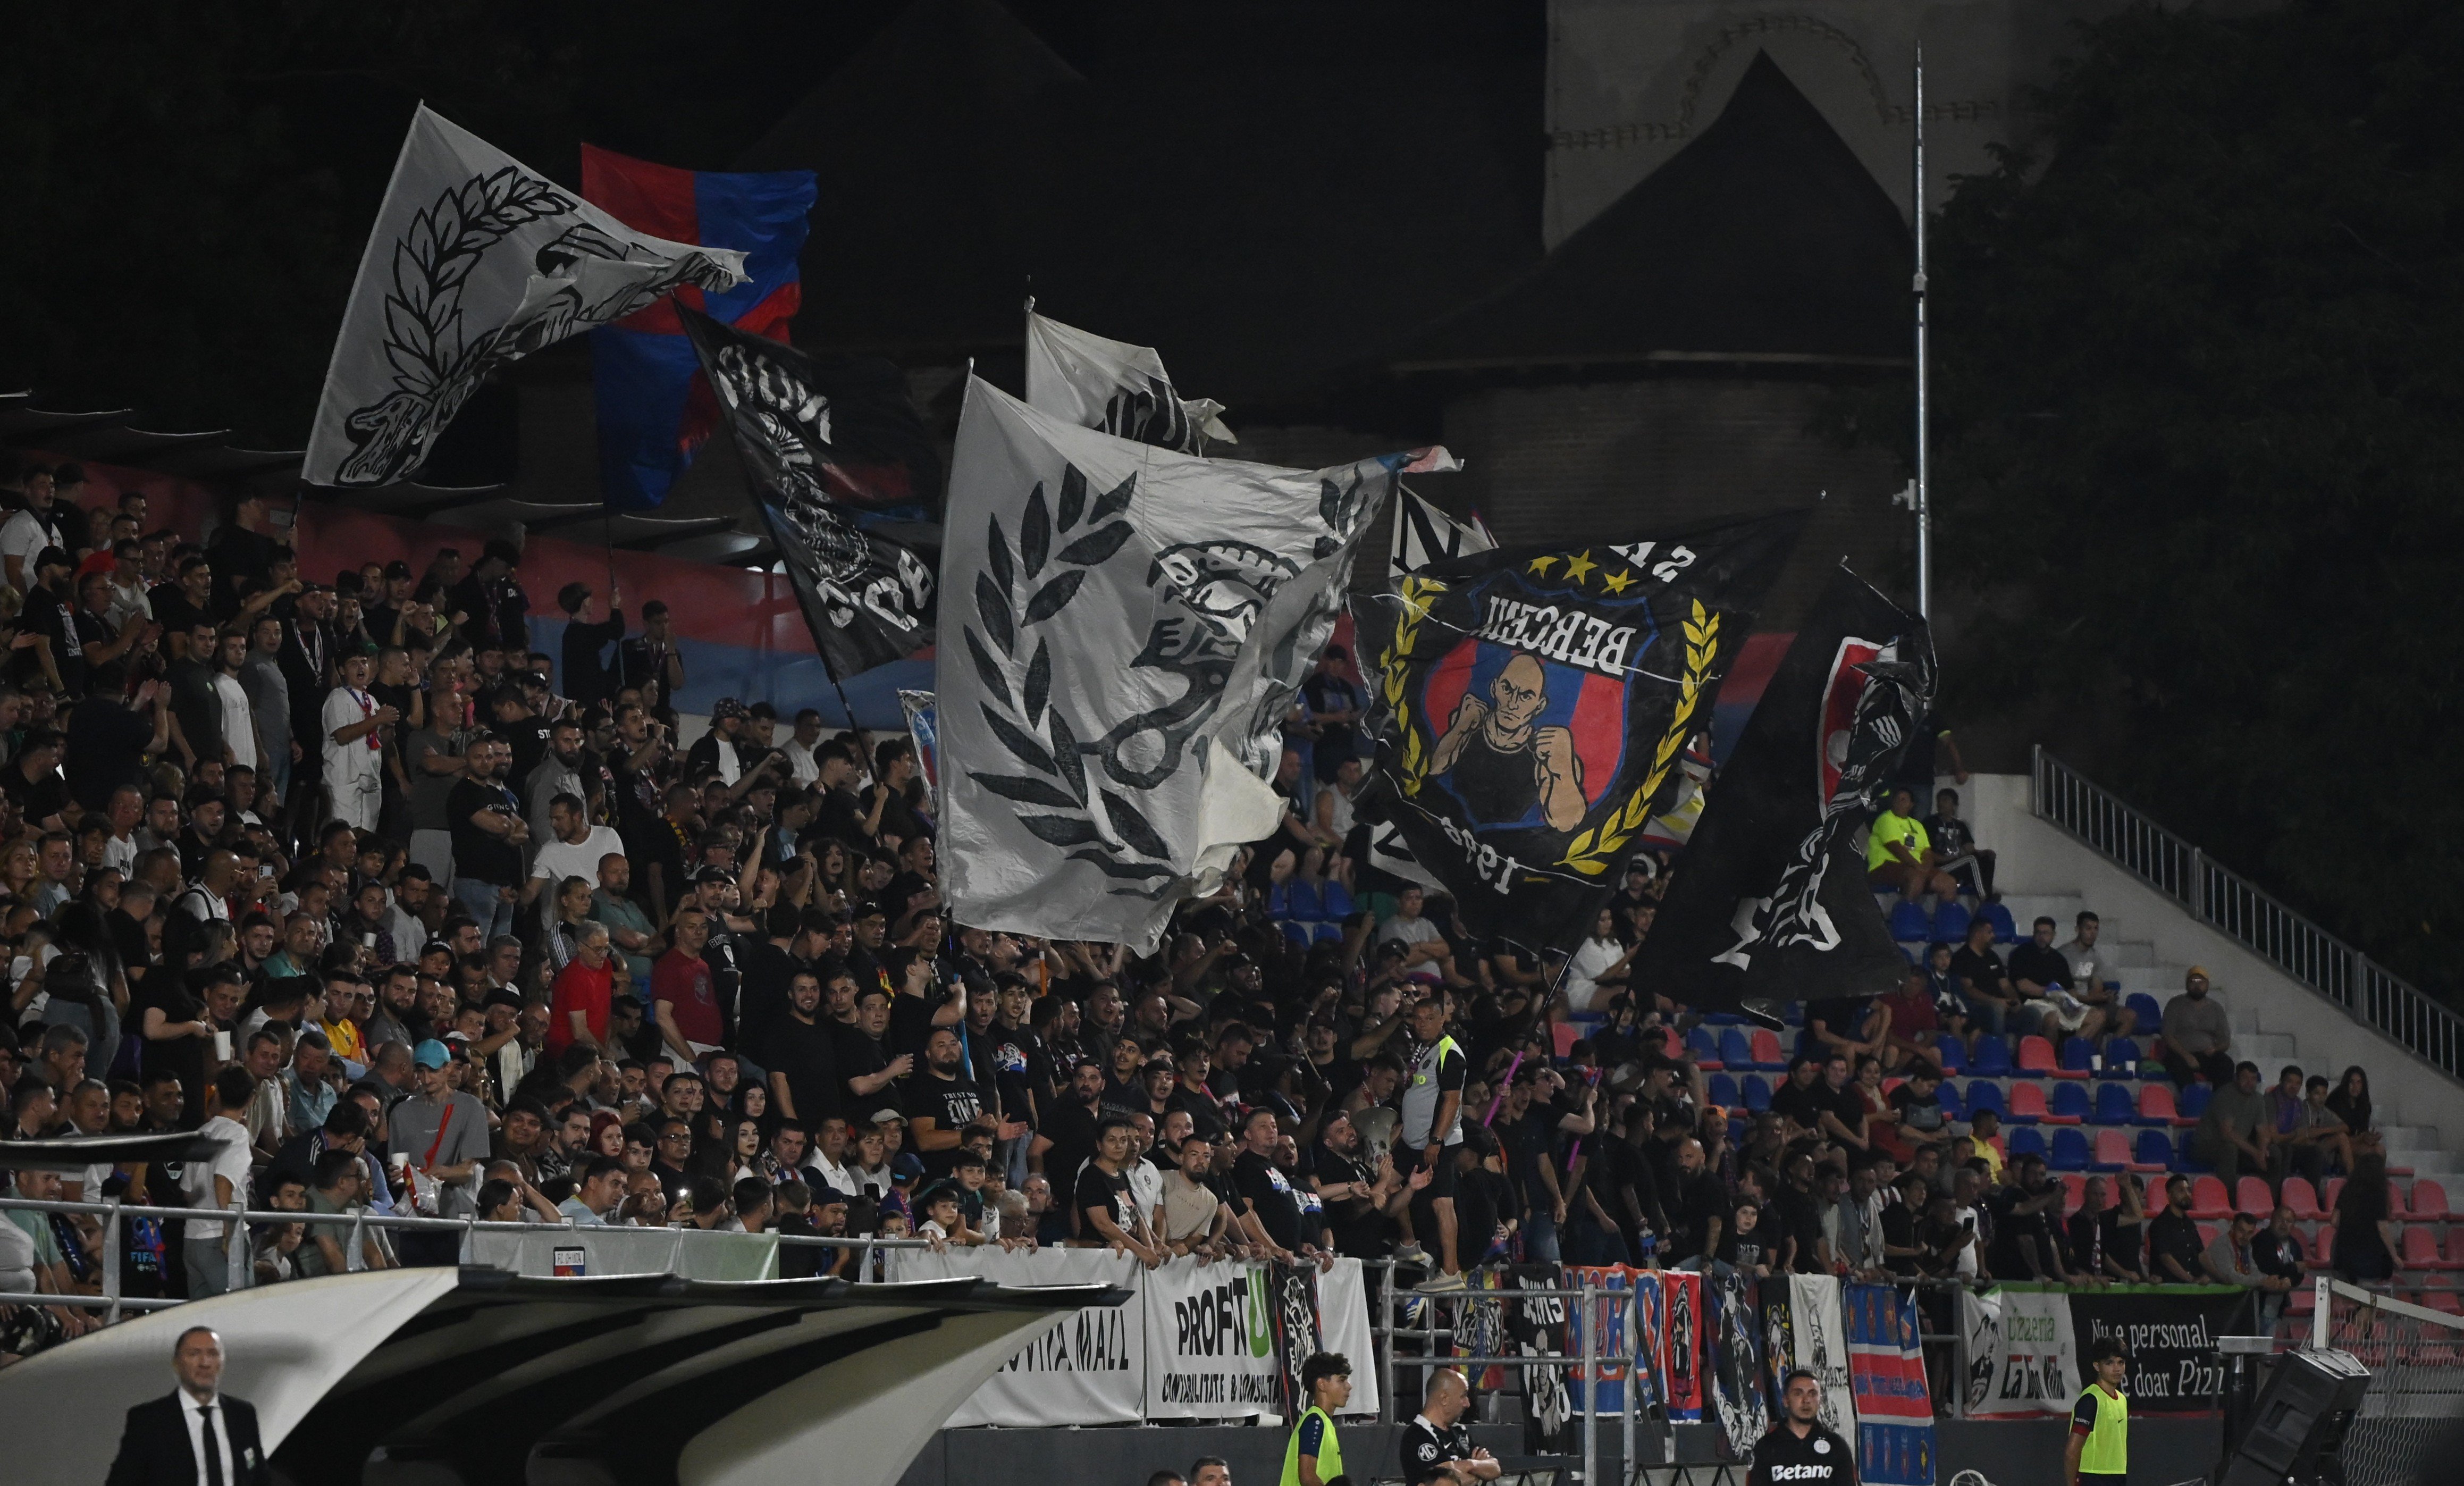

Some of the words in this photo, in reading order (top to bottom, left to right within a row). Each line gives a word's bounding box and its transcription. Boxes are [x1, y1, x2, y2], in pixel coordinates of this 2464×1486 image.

[130, 1252, 157, 1262] FIFA
[1077, 1309, 1129, 1372] MALL
[2007, 1307, 2055, 1350] pizzeria
[1231, 1374, 1237, 1402] &
[1999, 1354, 2023, 1398] La
[2134, 1363, 2170, 1397] doar
[1419, 1445, 1437, 1460] MG
[1771, 1464, 1834, 1482] Betano
